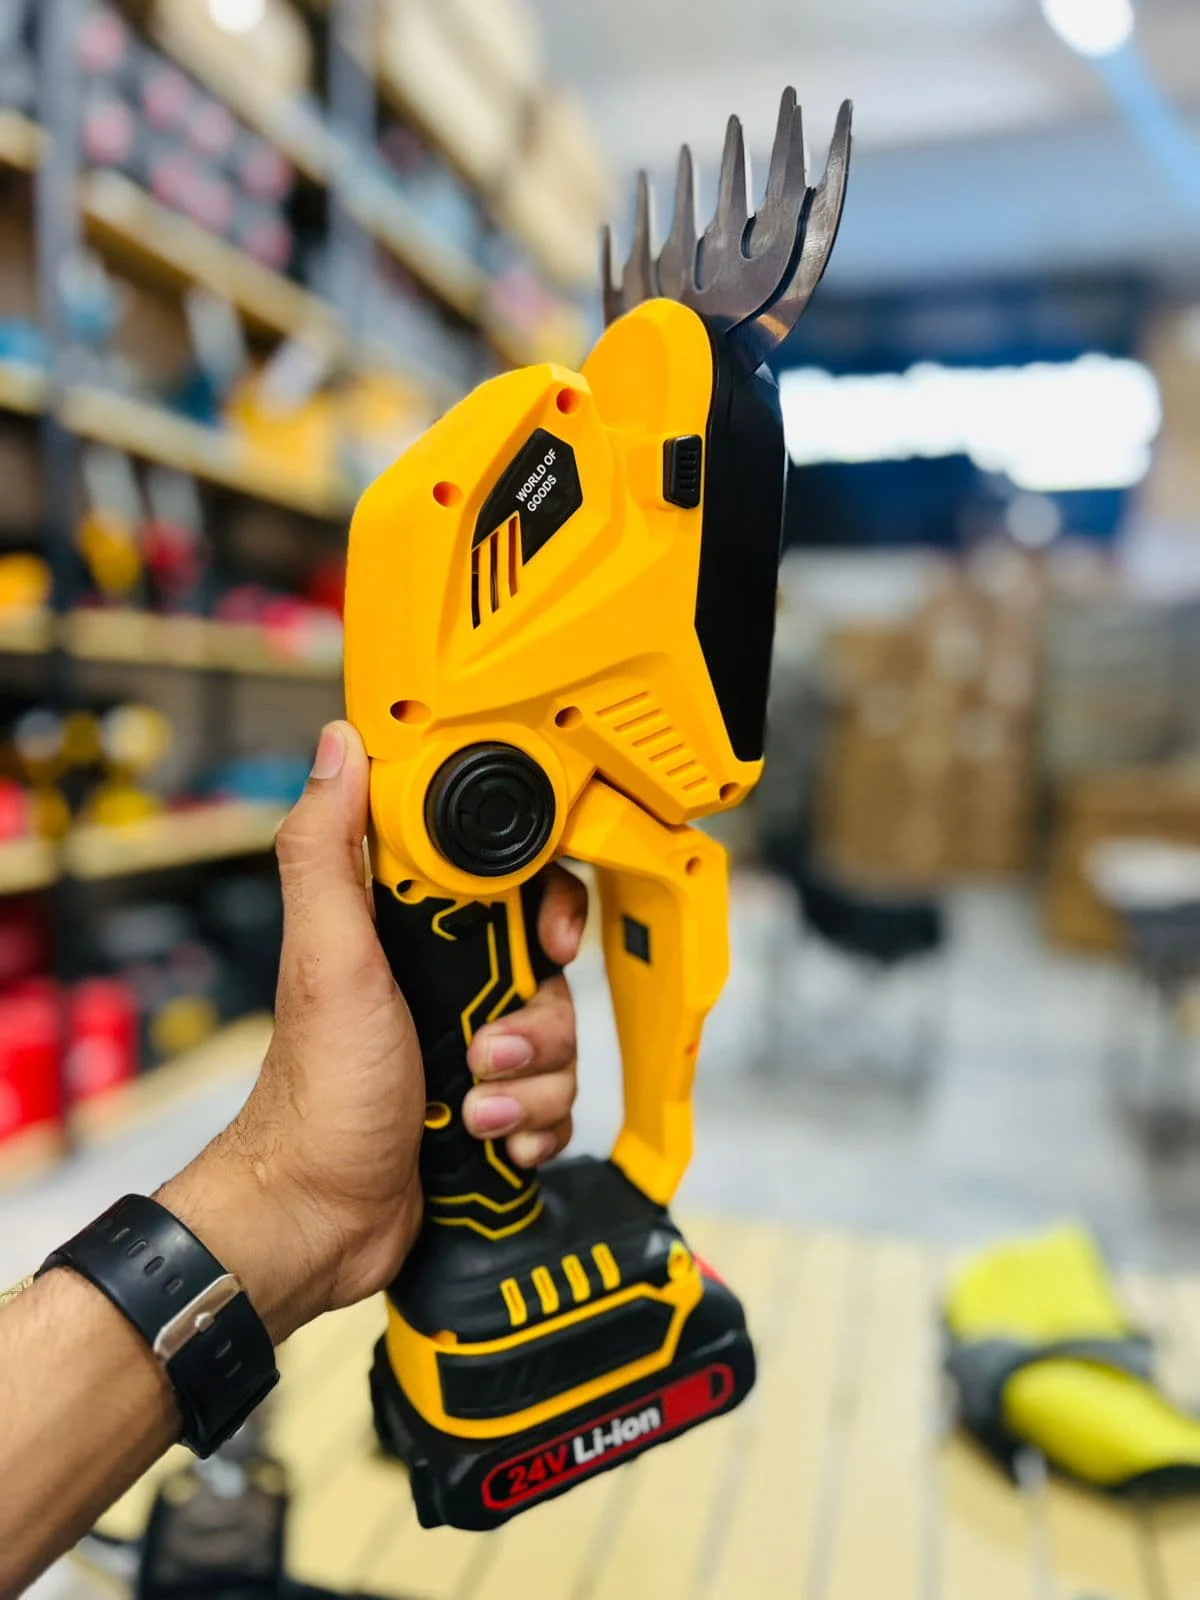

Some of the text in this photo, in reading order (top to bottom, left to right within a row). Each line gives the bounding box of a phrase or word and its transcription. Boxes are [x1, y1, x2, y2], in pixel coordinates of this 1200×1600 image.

[515, 448, 556, 502] WORLD OF
[527, 475, 557, 512] GOODS
[508, 1407, 661, 1496] 24V Li-ion
